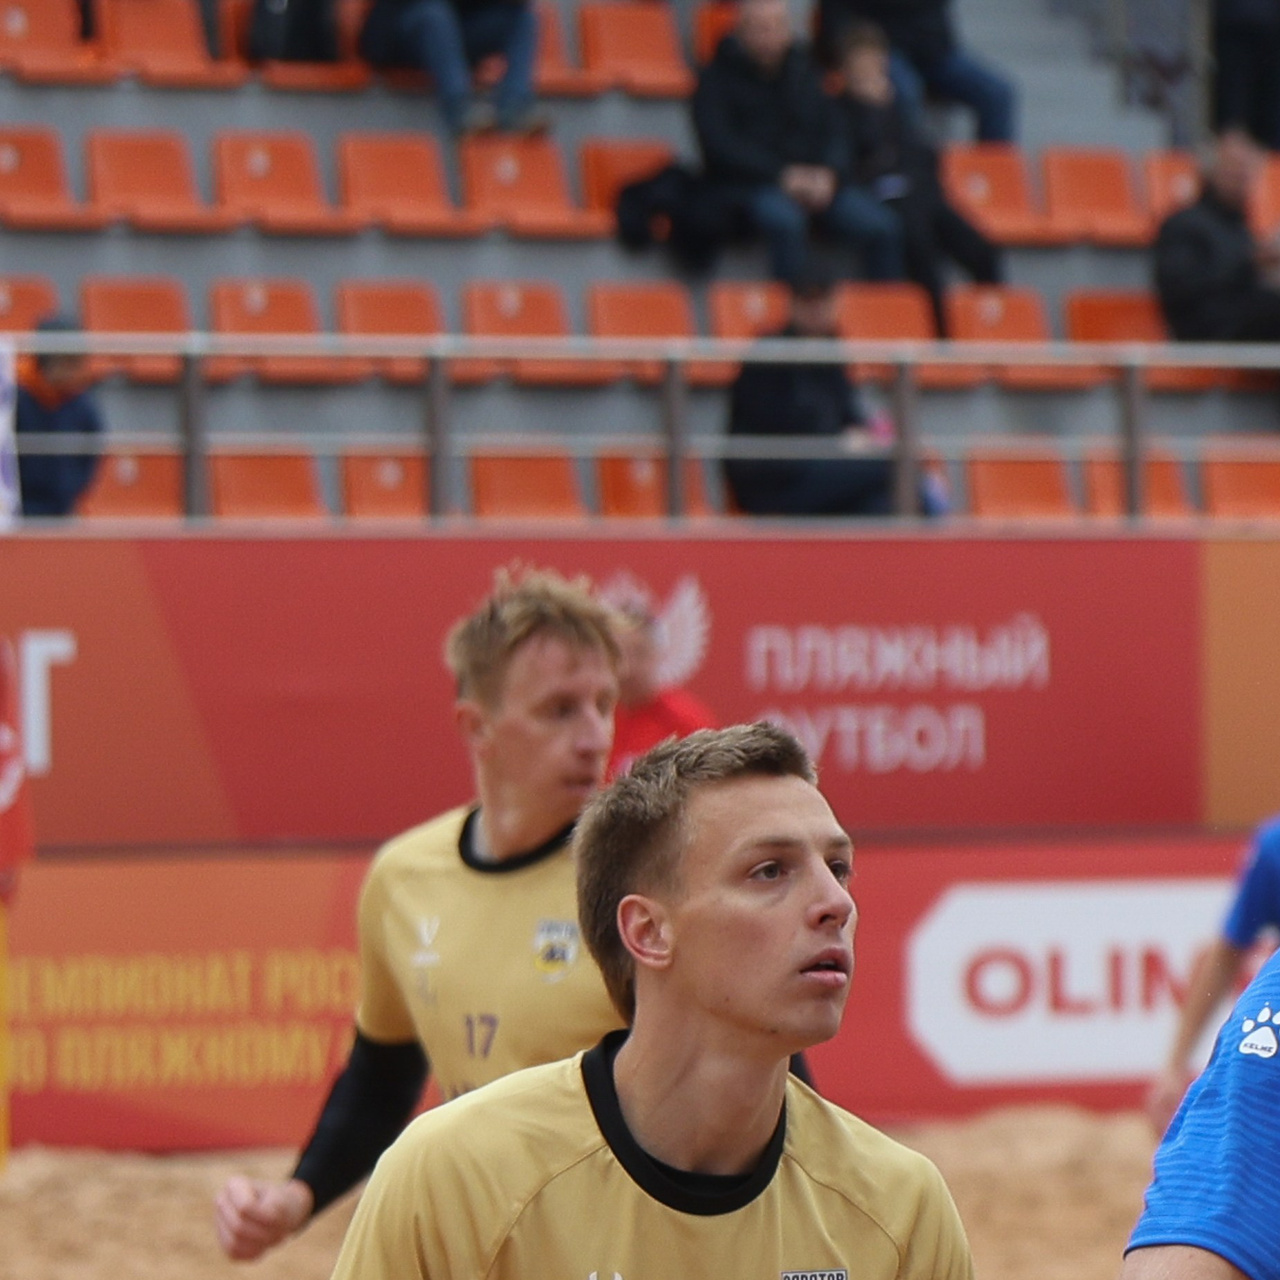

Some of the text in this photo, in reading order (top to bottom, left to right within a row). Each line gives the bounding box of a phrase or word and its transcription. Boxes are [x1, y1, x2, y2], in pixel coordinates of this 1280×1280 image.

[746, 613, 1049, 691] ПЛЯЖНЫЙ
[8, 955, 250, 1012] ЕМПИОНАТ
[962, 945, 1192, 1015] OLIM
[463, 1013, 499, 1060] 17
[1242, 1042, 1275, 1054] KELME
